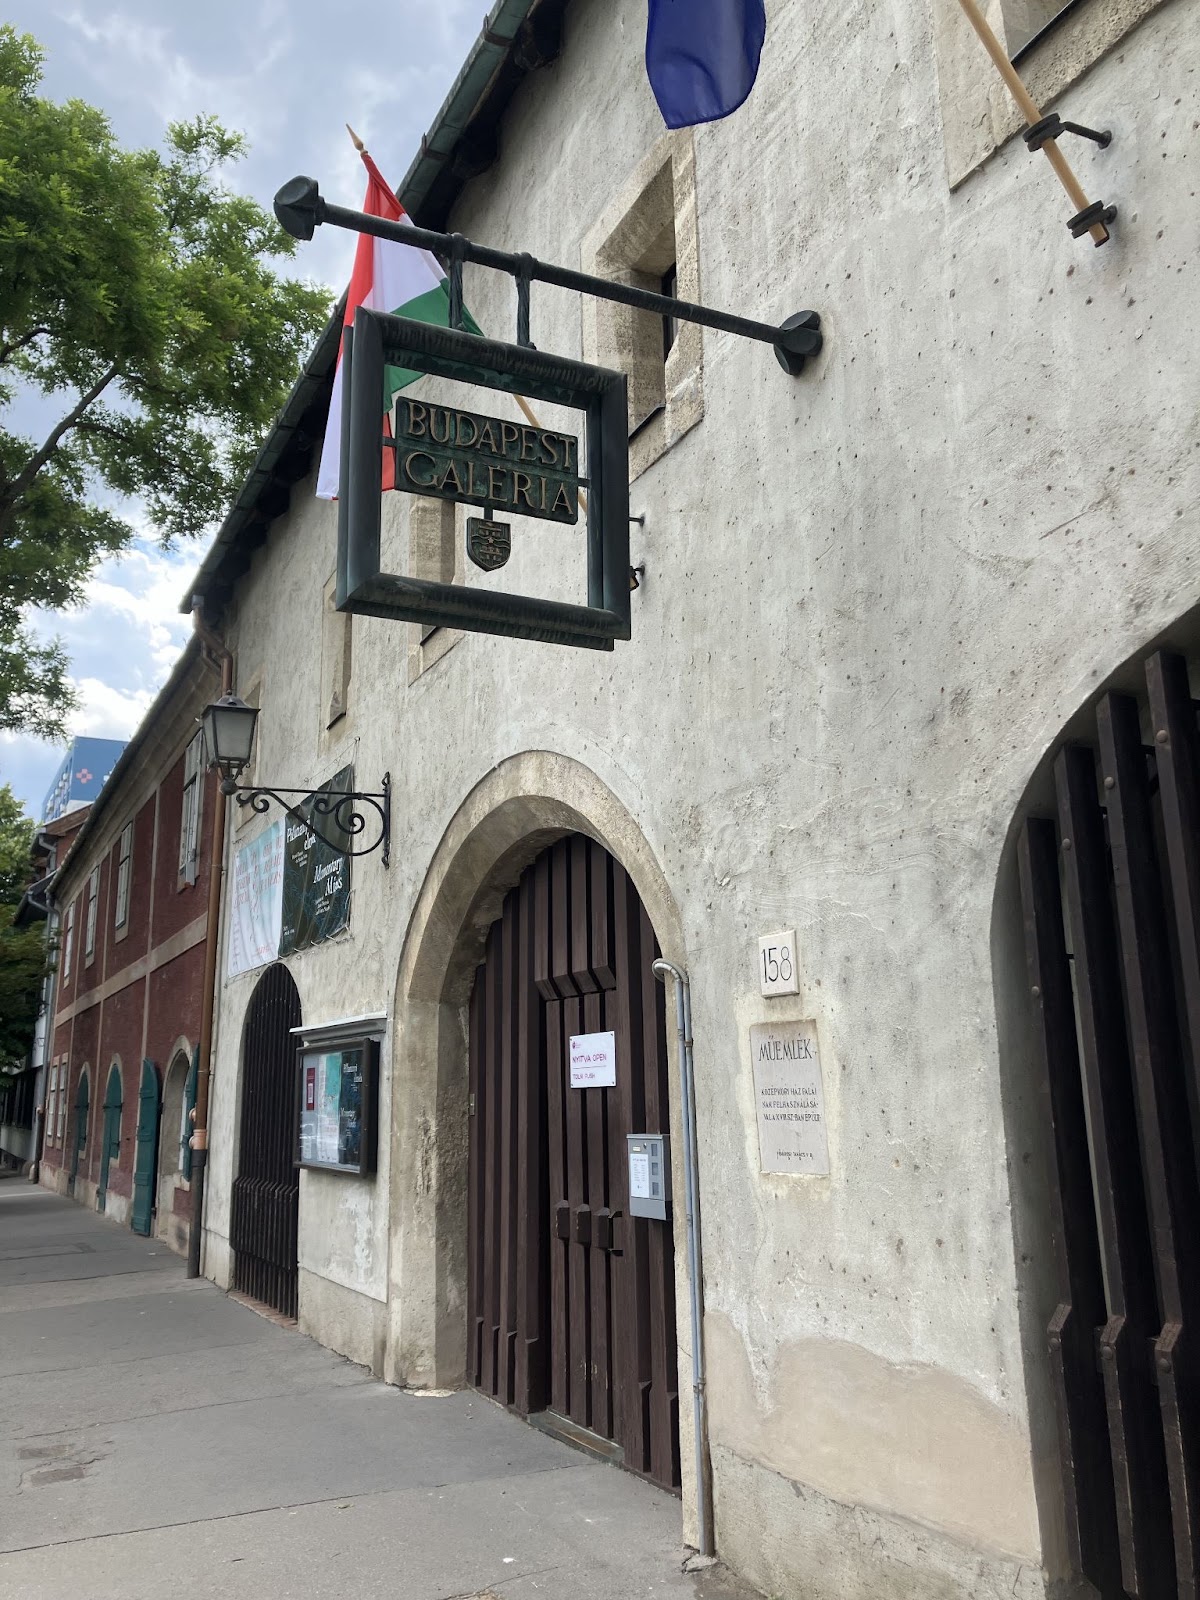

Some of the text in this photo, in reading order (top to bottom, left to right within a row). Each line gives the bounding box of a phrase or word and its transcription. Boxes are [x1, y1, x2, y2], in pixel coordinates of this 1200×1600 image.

[407, 401, 576, 468] BUDAPEST
[405, 451, 574, 516] GALÉRIA
[760, 945, 792, 983] 158
[572, 1053, 607, 1064] NYITVA OPEN
[758, 1033, 813, 1062] MŰEMLÉK
